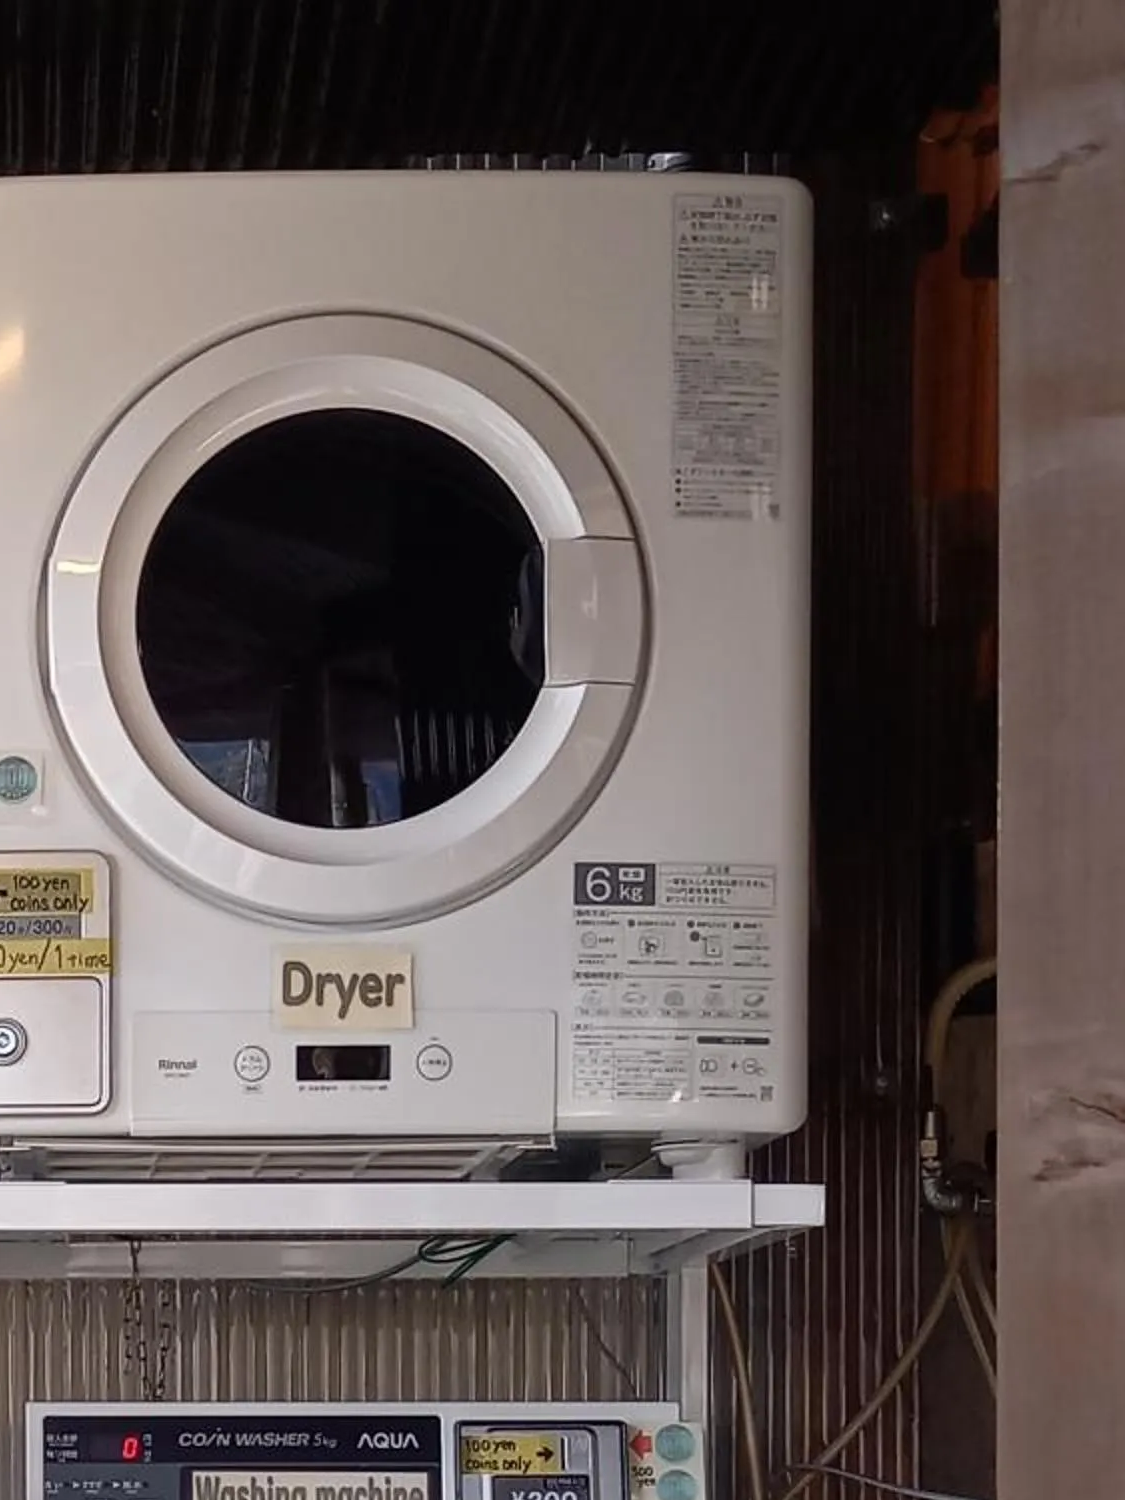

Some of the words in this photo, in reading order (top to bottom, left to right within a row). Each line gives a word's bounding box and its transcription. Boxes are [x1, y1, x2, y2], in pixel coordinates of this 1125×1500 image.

[12, 876, 40, 892] 100
[42, 877, 70, 892] yen
[586, 866, 612, 902] 6
[10, 896, 49, 912] coins
[54, 894, 89, 913] only
[282, 961, 405, 1019] Dryer
[122, 1437, 137, 1458] 0
[235, 1432, 309, 1447] WASHER
[313, 1432, 338, 1448] 5kg
[357, 1432, 419, 1448] AQUA
[492, 1440, 516, 1452] yen
[465, 1459, 498, 1471] coins
[503, 1457, 532, 1473] only
